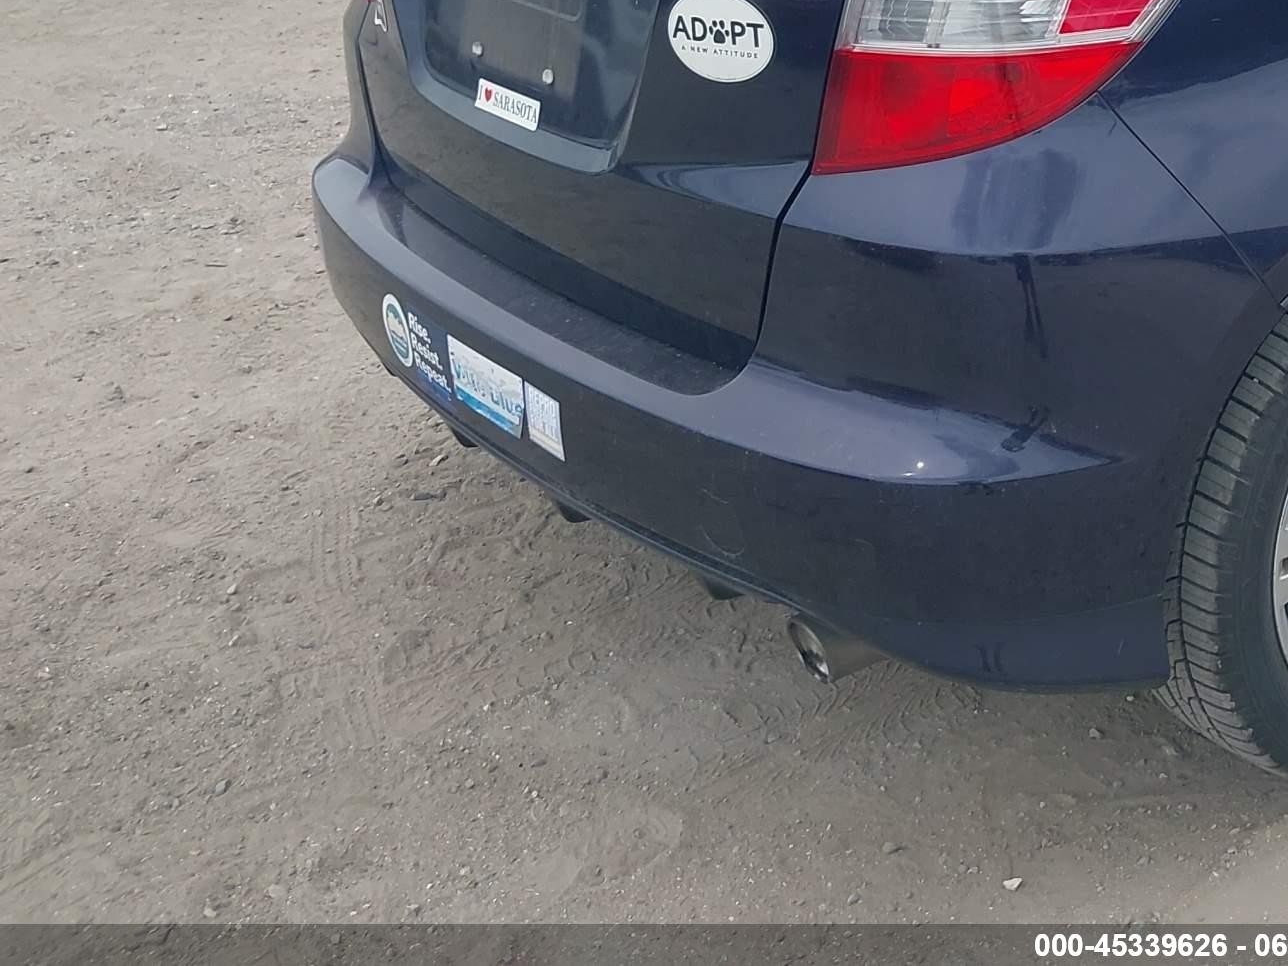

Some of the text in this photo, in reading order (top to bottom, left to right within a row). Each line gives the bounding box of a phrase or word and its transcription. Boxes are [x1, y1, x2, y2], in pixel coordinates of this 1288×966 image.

[713, 49, 758, 59] ATTITUDE
[493, 92, 537, 124] SARASOTA
[408, 312, 431, 344] Rise.
[411, 332, 443, 370] Resist.
[414, 351, 452, 394] Repeat.
